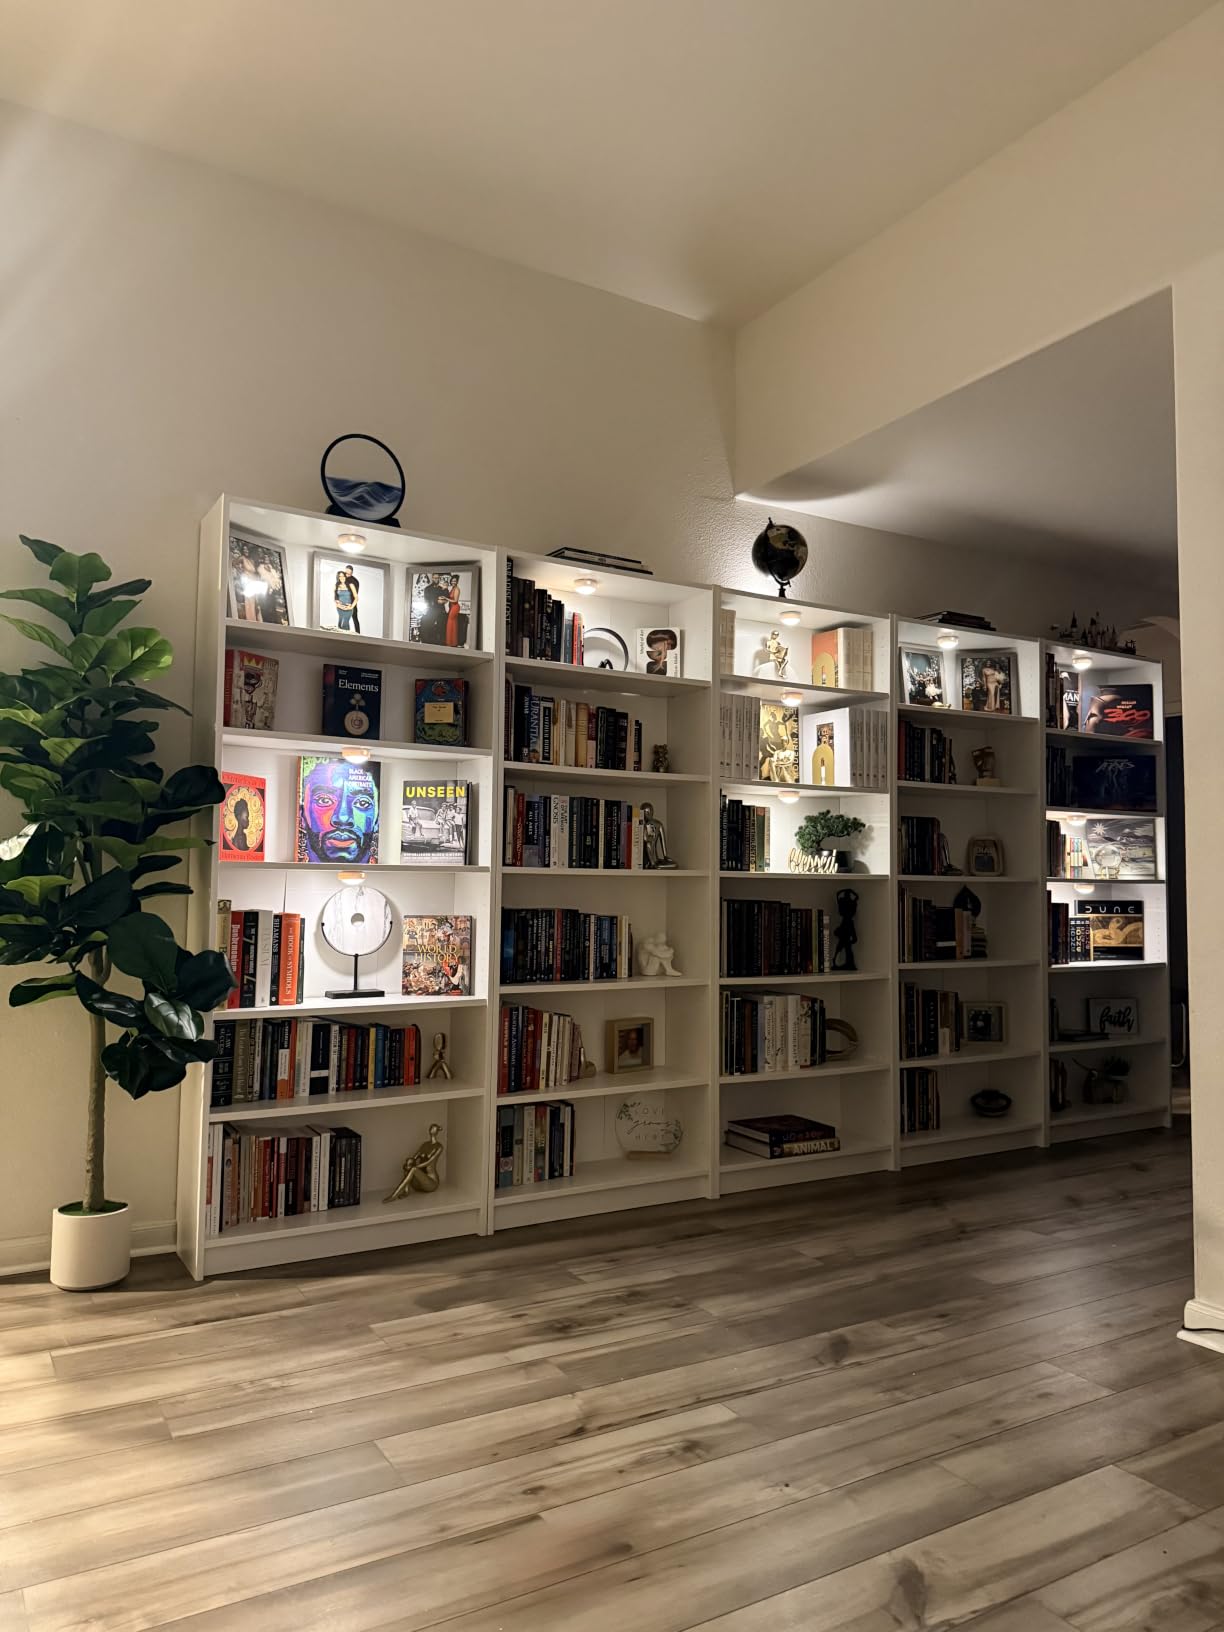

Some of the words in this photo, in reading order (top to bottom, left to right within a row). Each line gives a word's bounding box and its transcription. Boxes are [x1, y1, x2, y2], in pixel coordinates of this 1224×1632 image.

[338, 679, 379, 692] Elements
[530, 701, 539, 743] URANTIA
[1103, 708, 1151, 725] 300
[406, 786, 465, 798] UNSEEN
[1084, 905, 1135, 913] DUNE
[272, 918, 280, 952] SHAMANS
[231, 924, 240, 972] Pandemonium
[418, 945, 457, 953] WORLD
[416, 953, 462, 963] HISTORY
[285, 961, 293, 995] SYMBOLS
[1100, 1007, 1134, 1032] faith
[792, 1141, 833, 1154] ANIMAL
